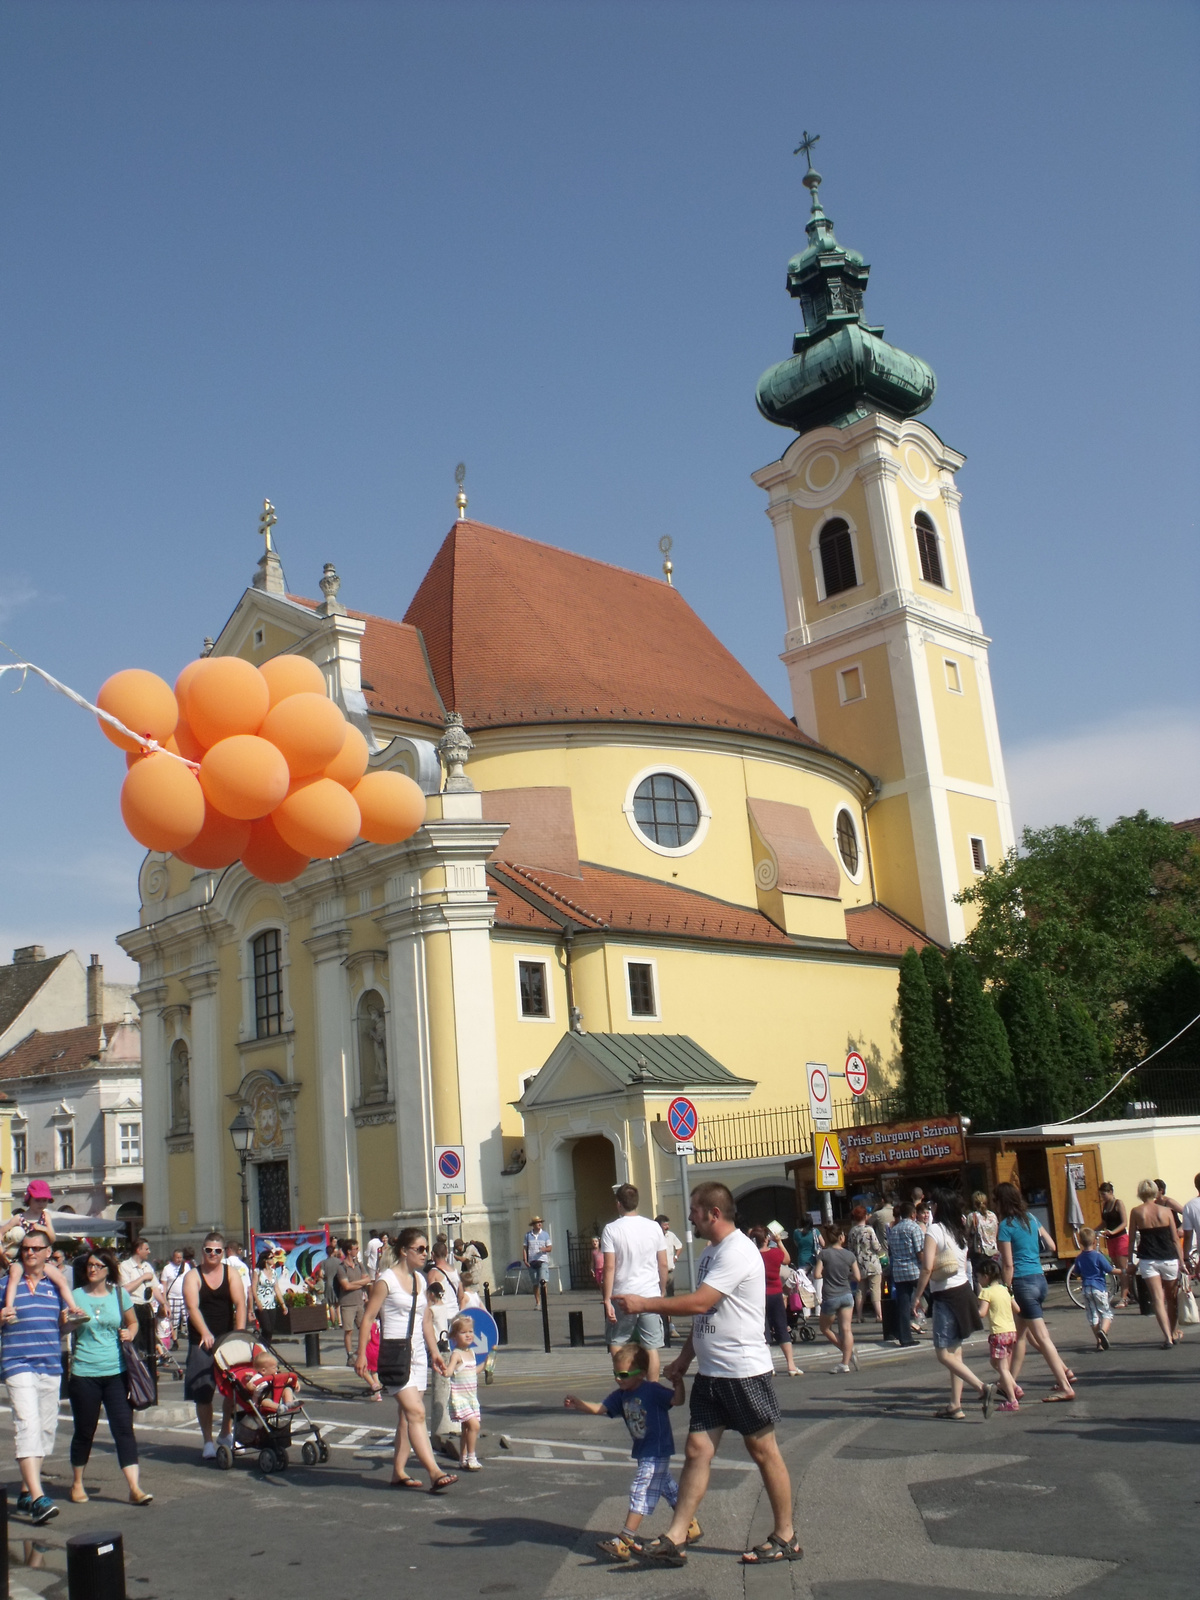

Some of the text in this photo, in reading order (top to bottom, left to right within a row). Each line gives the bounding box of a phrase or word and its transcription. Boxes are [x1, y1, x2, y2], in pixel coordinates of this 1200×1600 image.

[847, 1125, 958, 1147] Friss Burgonya Szirom
[859, 1144, 950, 1164] Fresh Potato Chips
